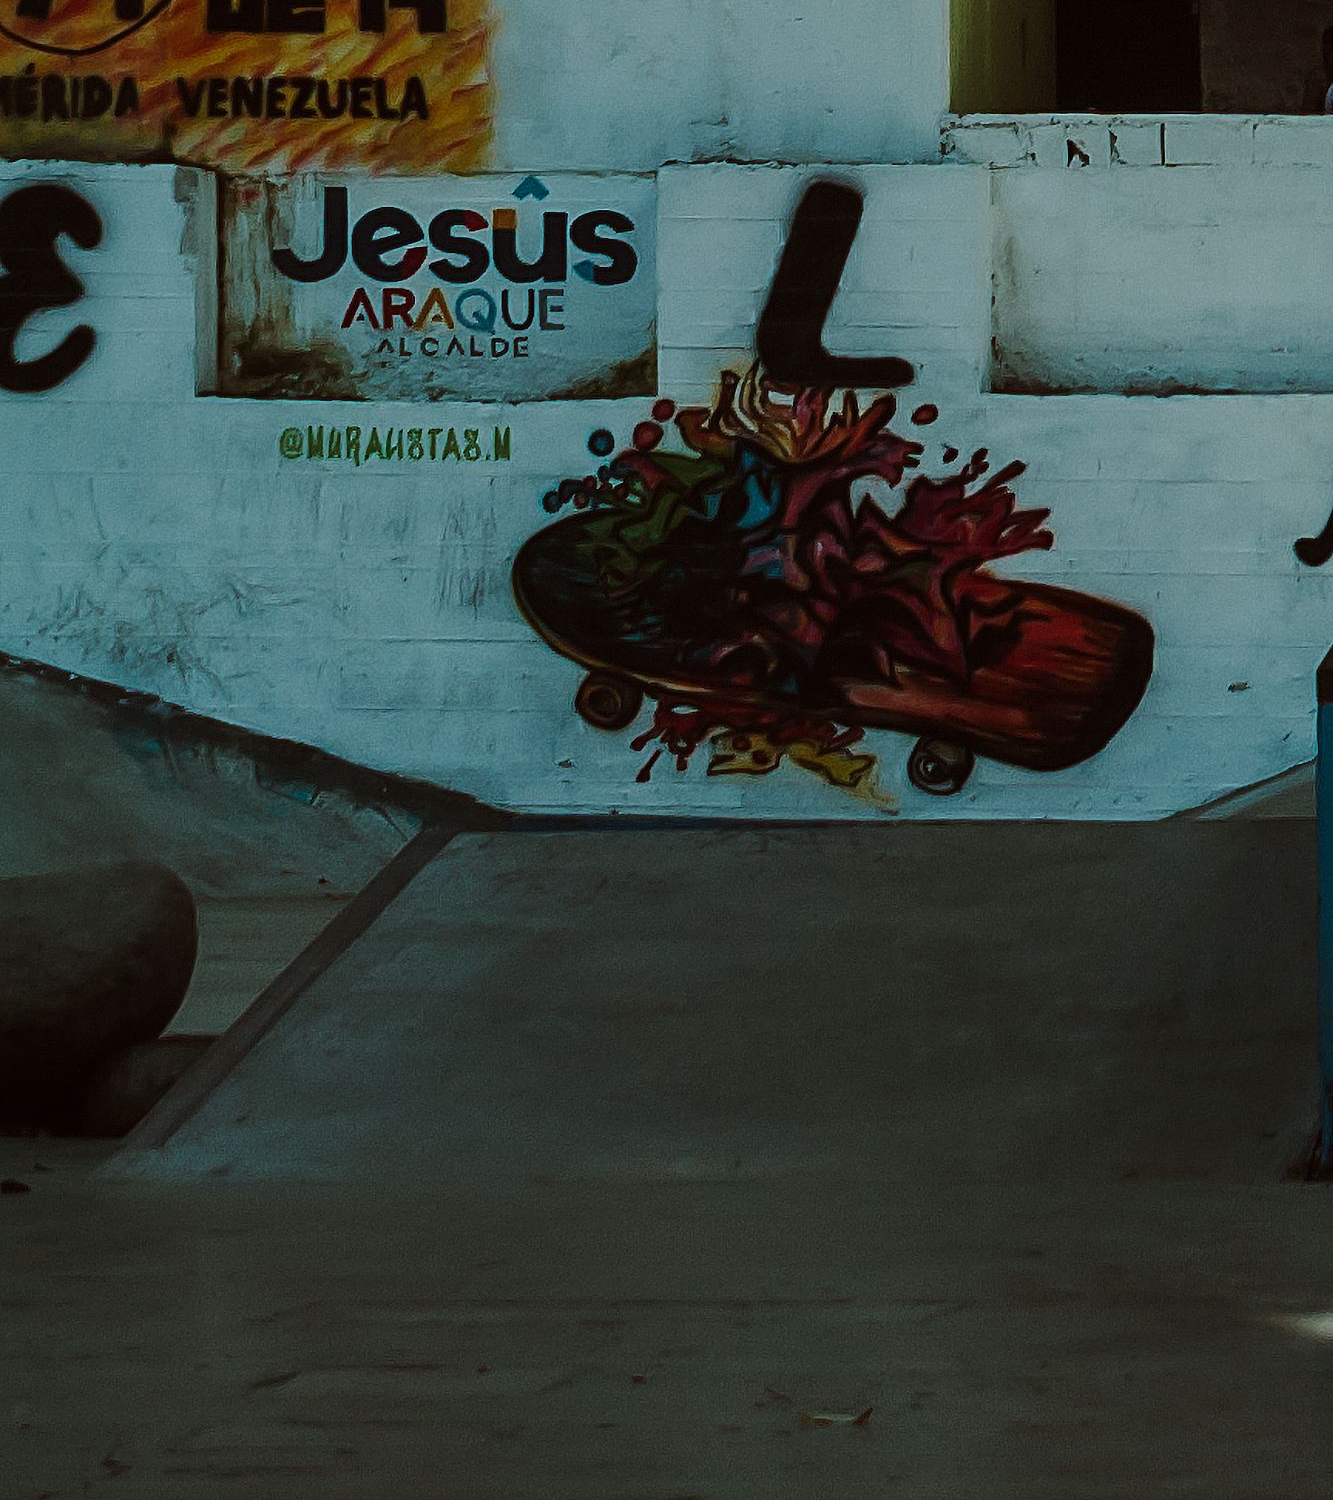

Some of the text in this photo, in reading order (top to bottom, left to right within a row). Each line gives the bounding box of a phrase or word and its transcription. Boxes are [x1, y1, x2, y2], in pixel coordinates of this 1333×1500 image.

[177, 75, 430, 121] VENEZUELA
[340, 287, 566, 334] ARAQUE
[377, 335, 530, 358] ALCALDE
